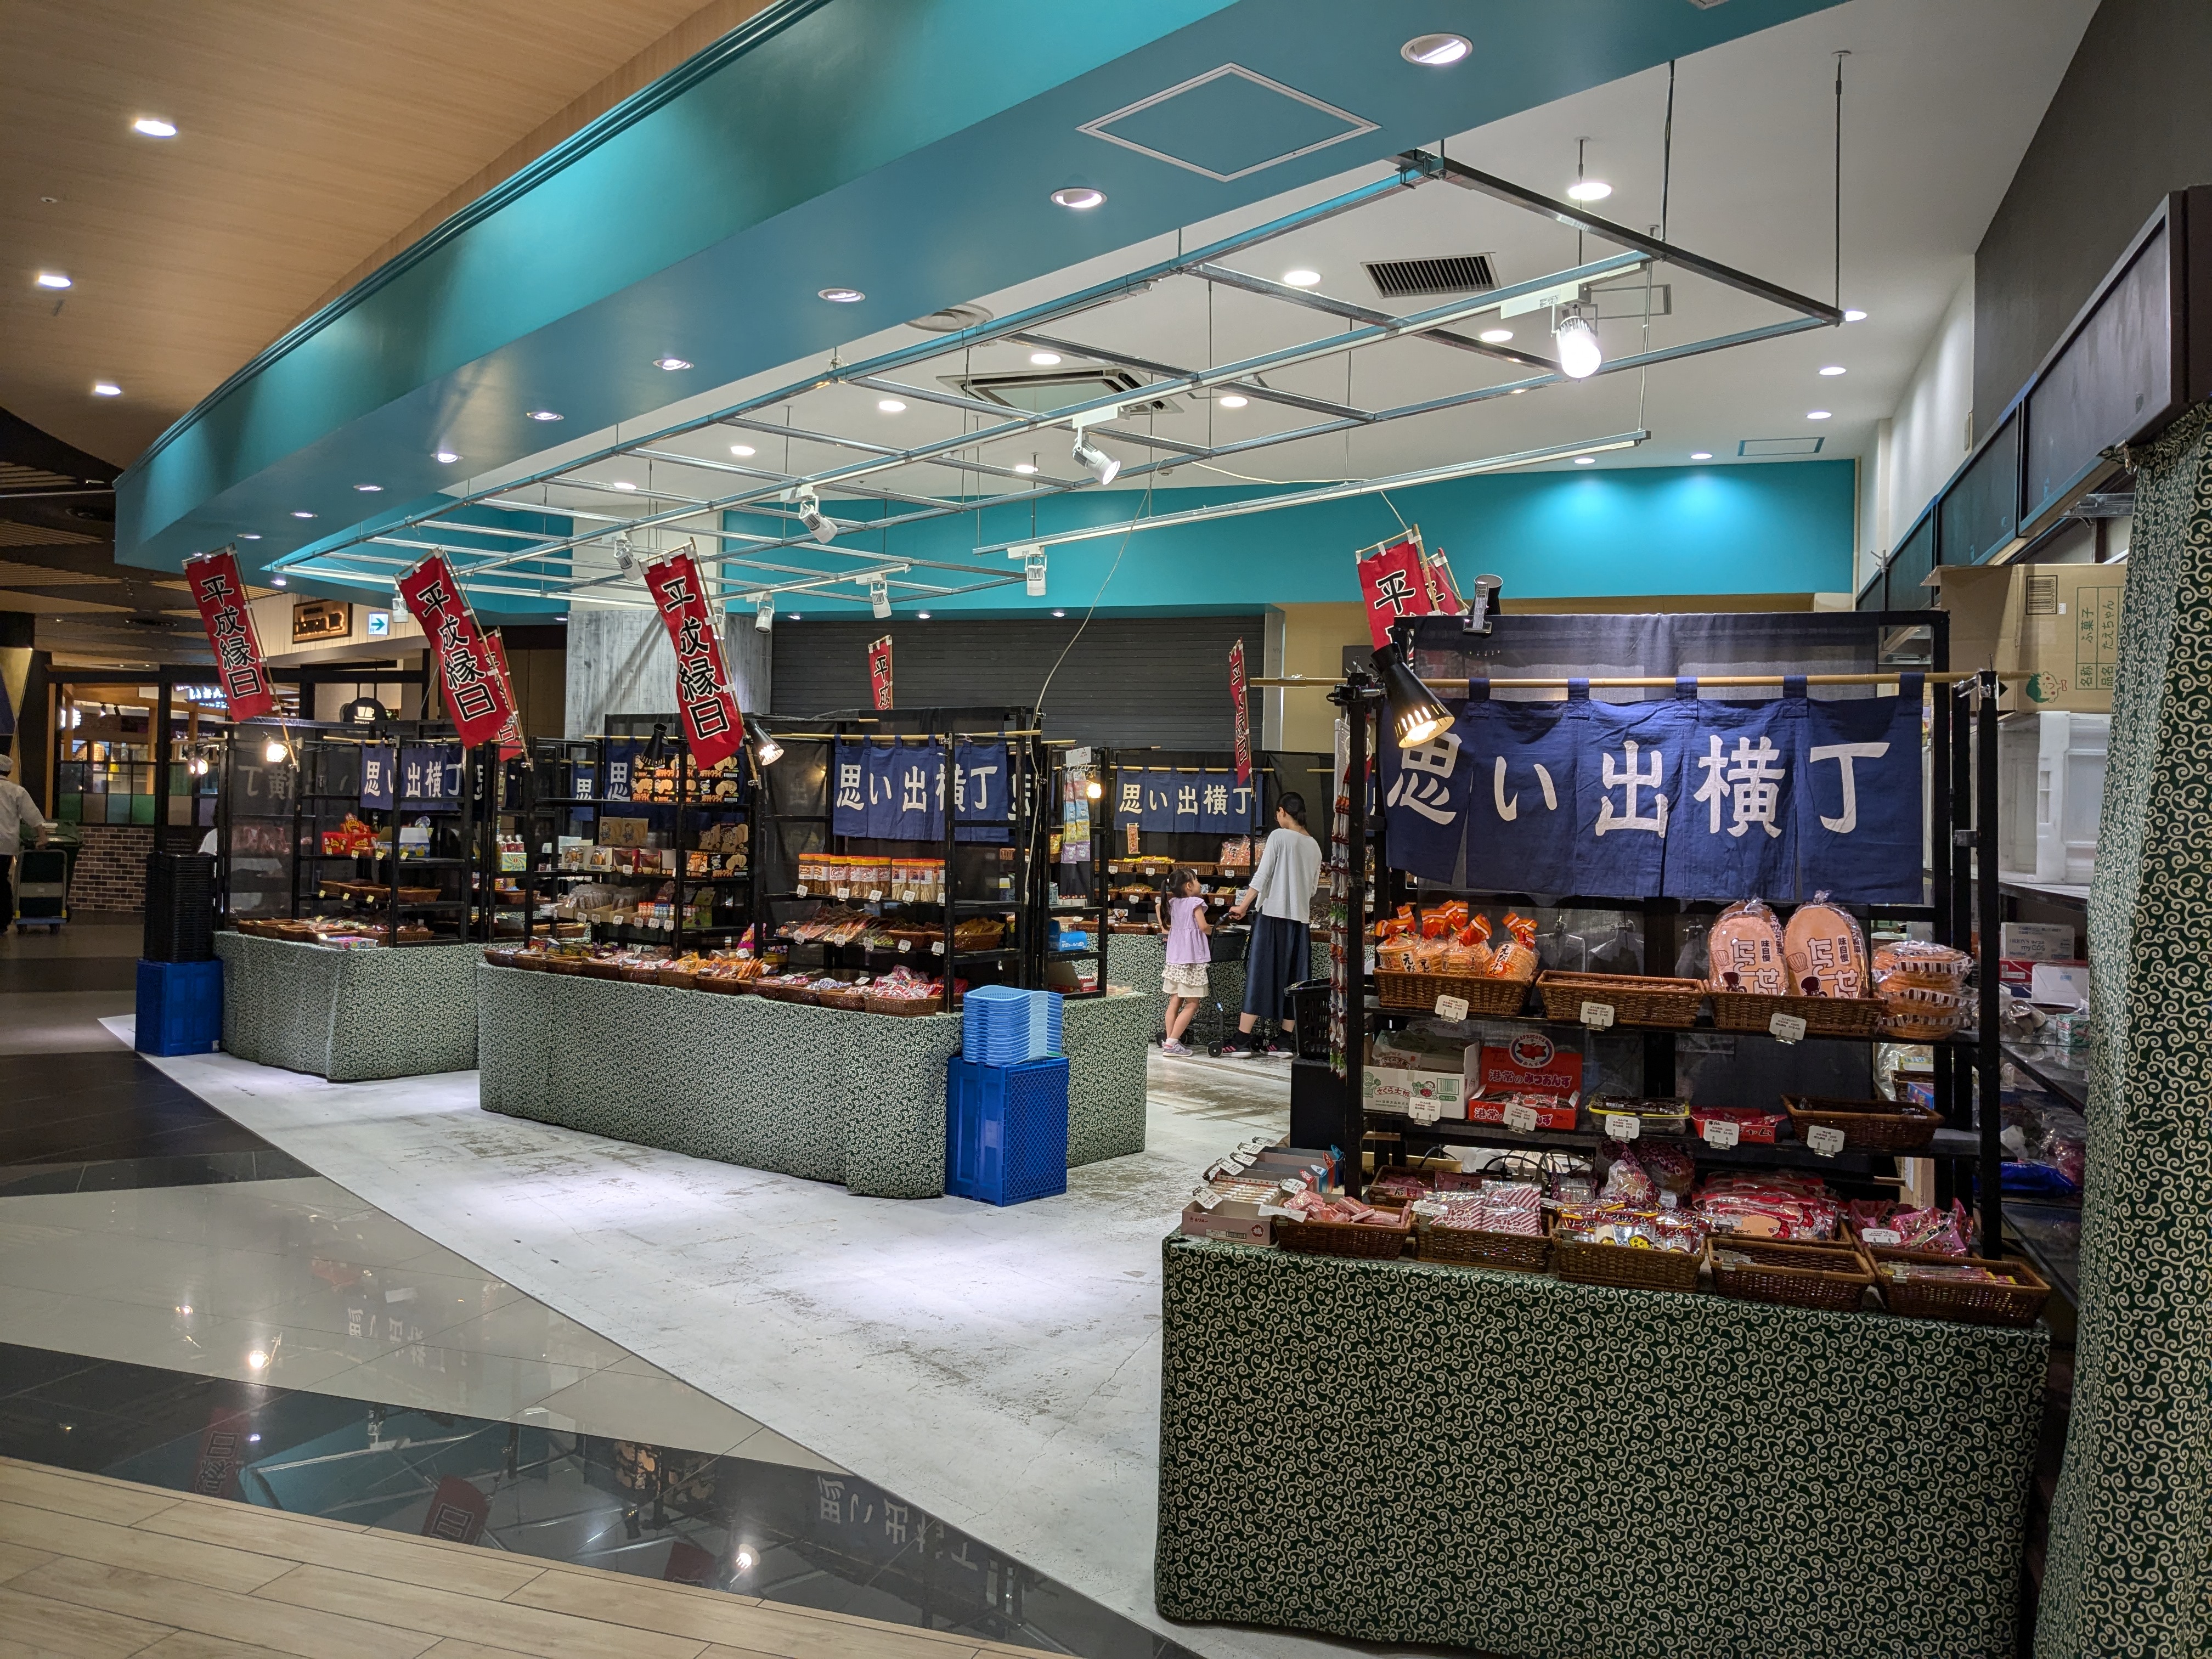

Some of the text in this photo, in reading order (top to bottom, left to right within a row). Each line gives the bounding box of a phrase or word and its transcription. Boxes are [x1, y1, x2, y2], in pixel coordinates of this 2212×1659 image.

[200, 575, 262, 699] 平成縁日
[2081, 607, 2094, 644] ふ菓子
[2102, 600, 2114, 650] たえちゃん
[416, 580, 497, 721] 平成縁日
[661, 575, 730, 740] 平成縁日
[873, 656, 891, 709] 平成
[2080, 665, 2094, 687] 名称
[2101, 666, 2114, 687] 品名
[837, 763, 998, 814] 思い出横丁
[1119, 782, 1253, 816] 思い出横丁
[1387, 730, 1891, 839] 思い出横丁
[1487, 944, 1512, 976] えび小丸
[1760, 940, 1771, 962] 味自慢
[1520, 1034, 1546, 1042] APRICOTS
[1488, 1069, 1572, 1088] 港常のみつあんず
[1447, 1208, 1465, 1216] ルク
